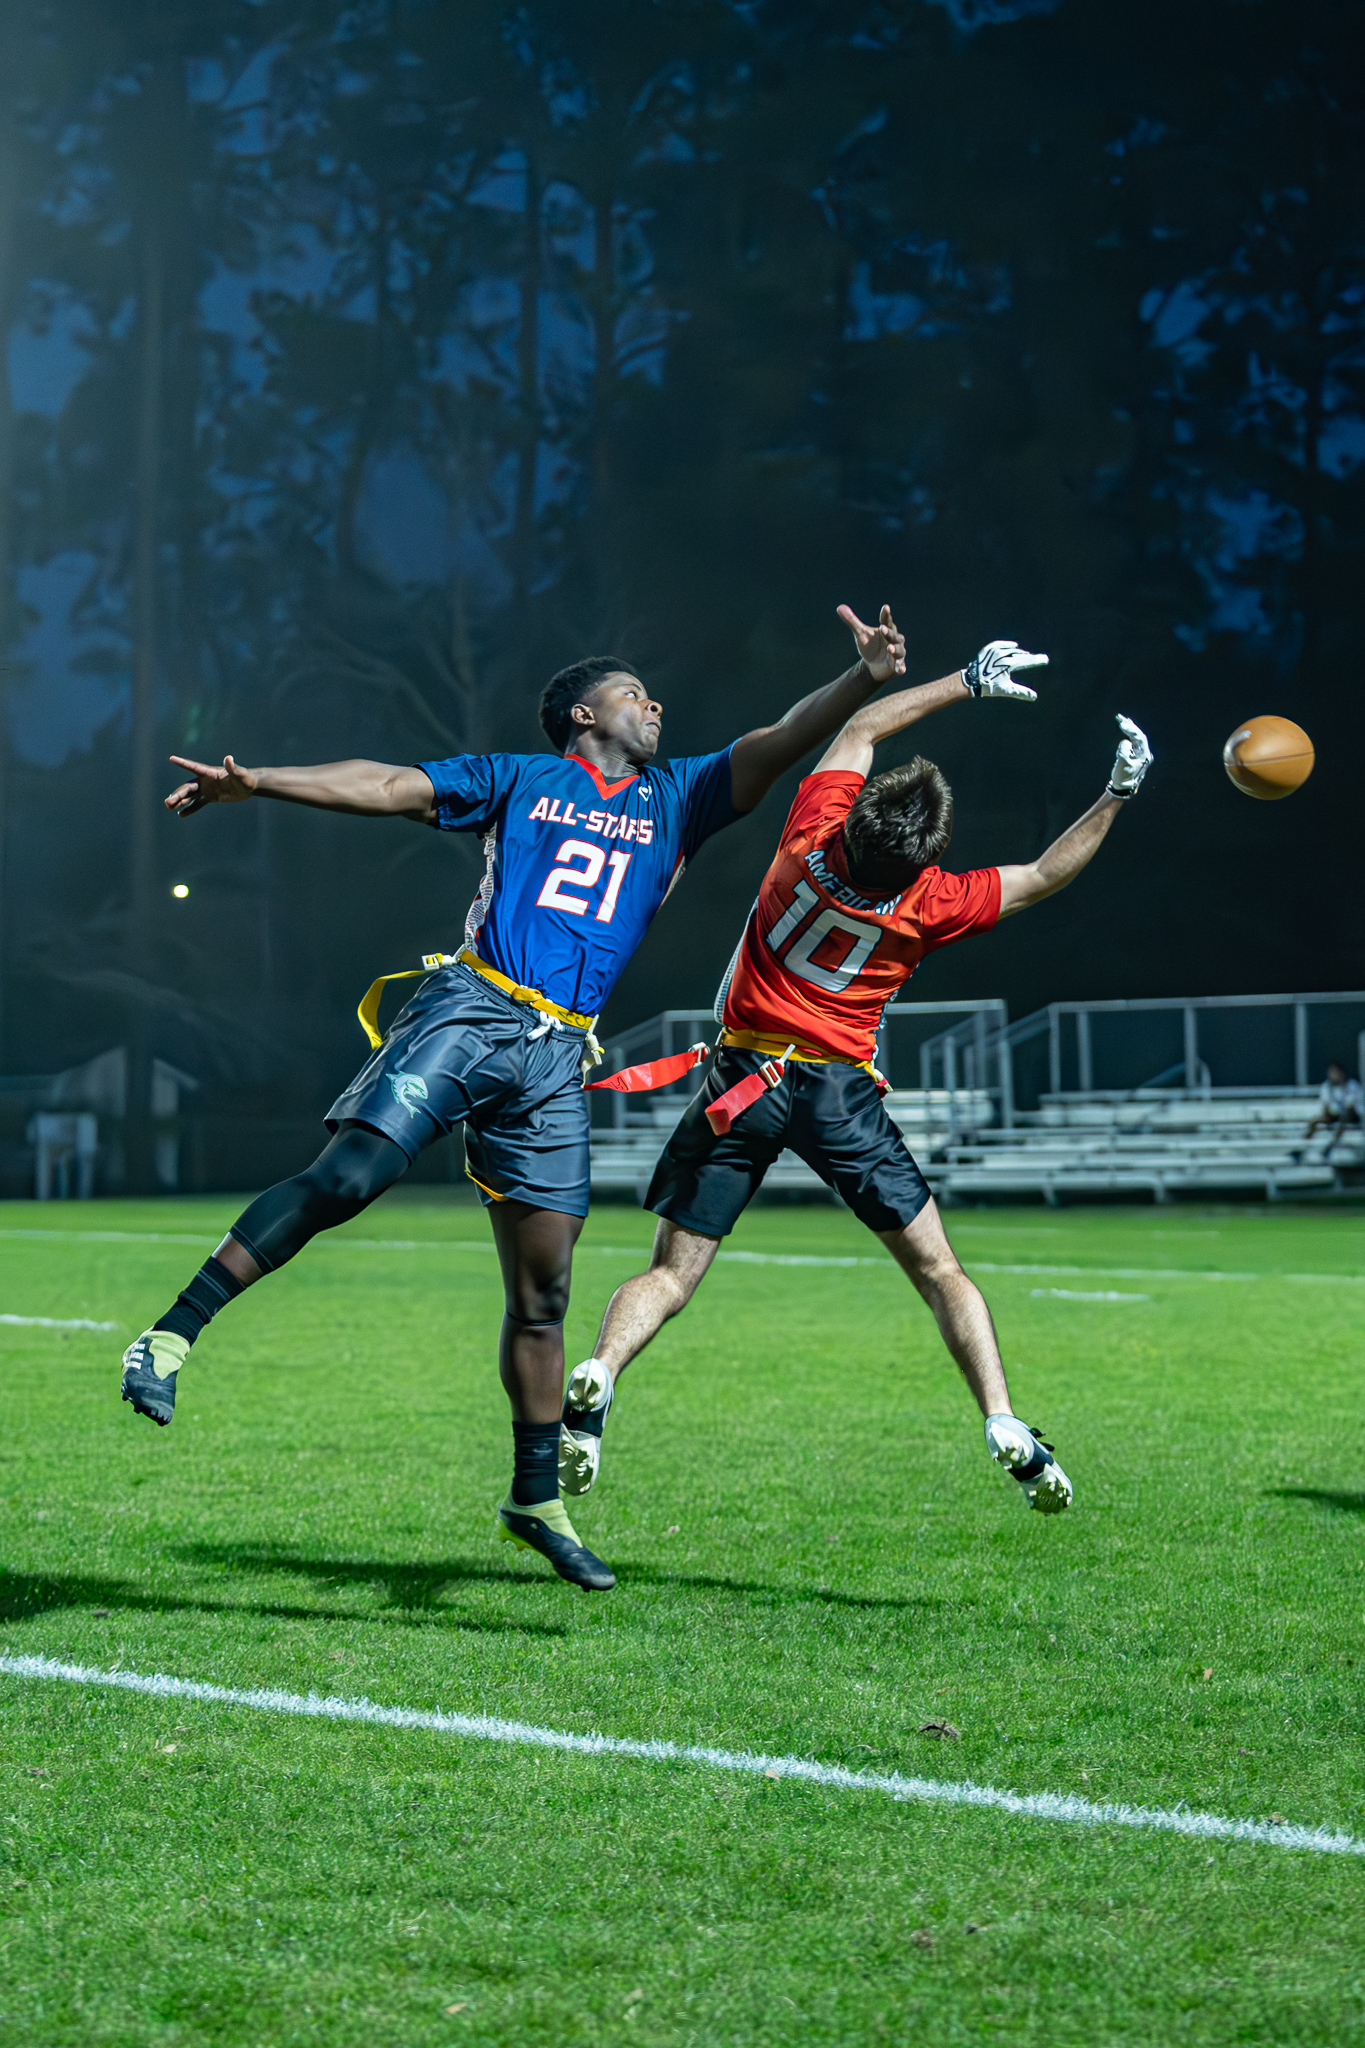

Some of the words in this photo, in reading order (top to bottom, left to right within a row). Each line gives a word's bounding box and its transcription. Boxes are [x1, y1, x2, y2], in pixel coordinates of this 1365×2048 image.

[528, 796, 653, 845] ALL-STARS
[535, 838, 633, 924] 21
[765, 878, 883, 993] 10
